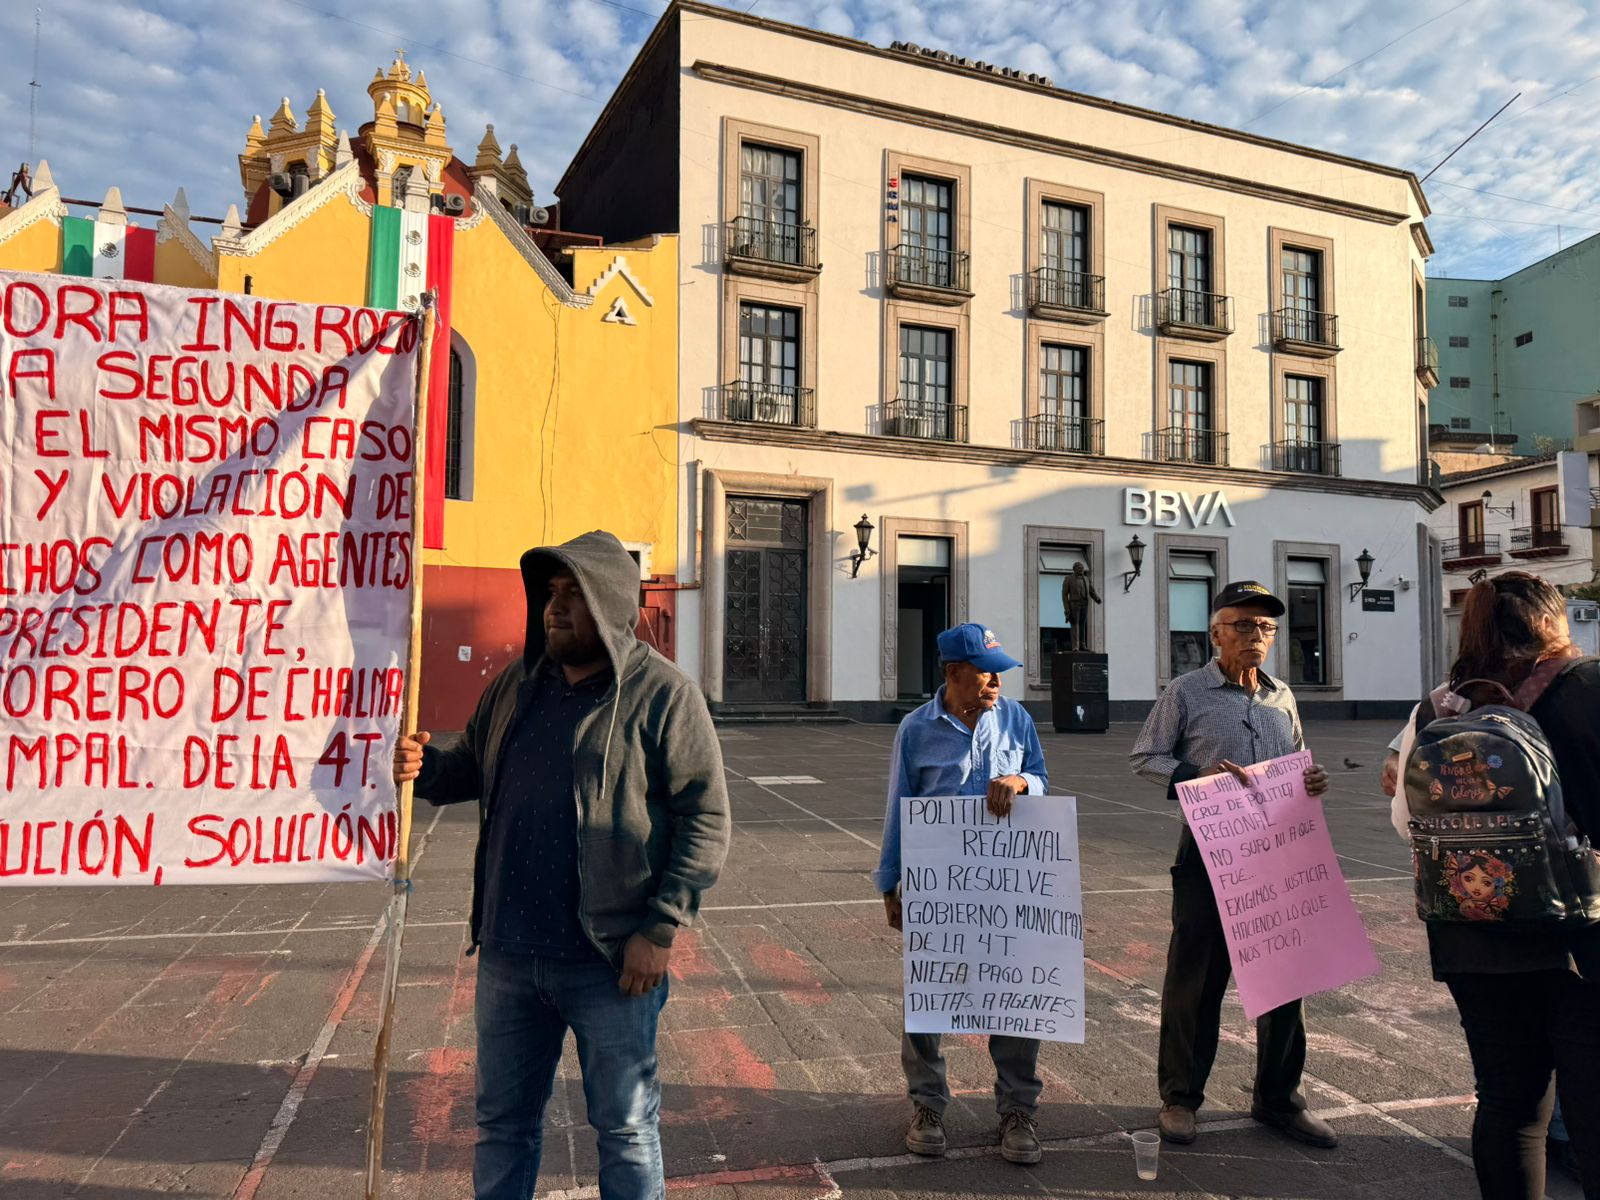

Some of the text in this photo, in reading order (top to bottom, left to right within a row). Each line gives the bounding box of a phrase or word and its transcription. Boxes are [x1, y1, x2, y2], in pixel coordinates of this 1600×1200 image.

[0, 282, 148, 342] ORA
[0, 349, 349, 412] A SEGUNDA
[36, 410, 414, 463] EL MISMO CASO
[35, 464, 414, 521] Y VIOLACIÓN DE
[1124, 487, 1237, 529] BBVA
[132, 532, 253, 585] COMO
[269, 532, 411, 589] AGENTES
[0, 665, 403, 722] ORERO DE CHALMA
[7, 733, 153, 791] MPAL.
[1262, 755, 1311, 780] BAUTISTA
[1192, 806, 1224, 821] CRUZ
[1226, 799, 1243, 811] DE
[1198, 810, 1278, 842] REGIONAL
[963, 830, 1071, 863] REGIONAL
[1210, 820, 1314, 867] NO SUPO NI A QUE
[907, 867, 937, 892] NO
[1225, 863, 1329, 917] EXIGIMOS JUSTICIA
[908, 901, 1082, 940] GOBIERNO MUNICIPAL
[1231, 896, 1328, 941] HACIENDO LO QUE
[909, 932, 936, 952] DE
[943, 933, 964, 954] LA
[1239, 947, 1260, 966] NOS
[911, 960, 1060, 986] NIEGA PAGO DE
[909, 992, 1076, 1018] DIETAS A AGENTES
[950, 1014, 1056, 1034] MUNICIPALES
